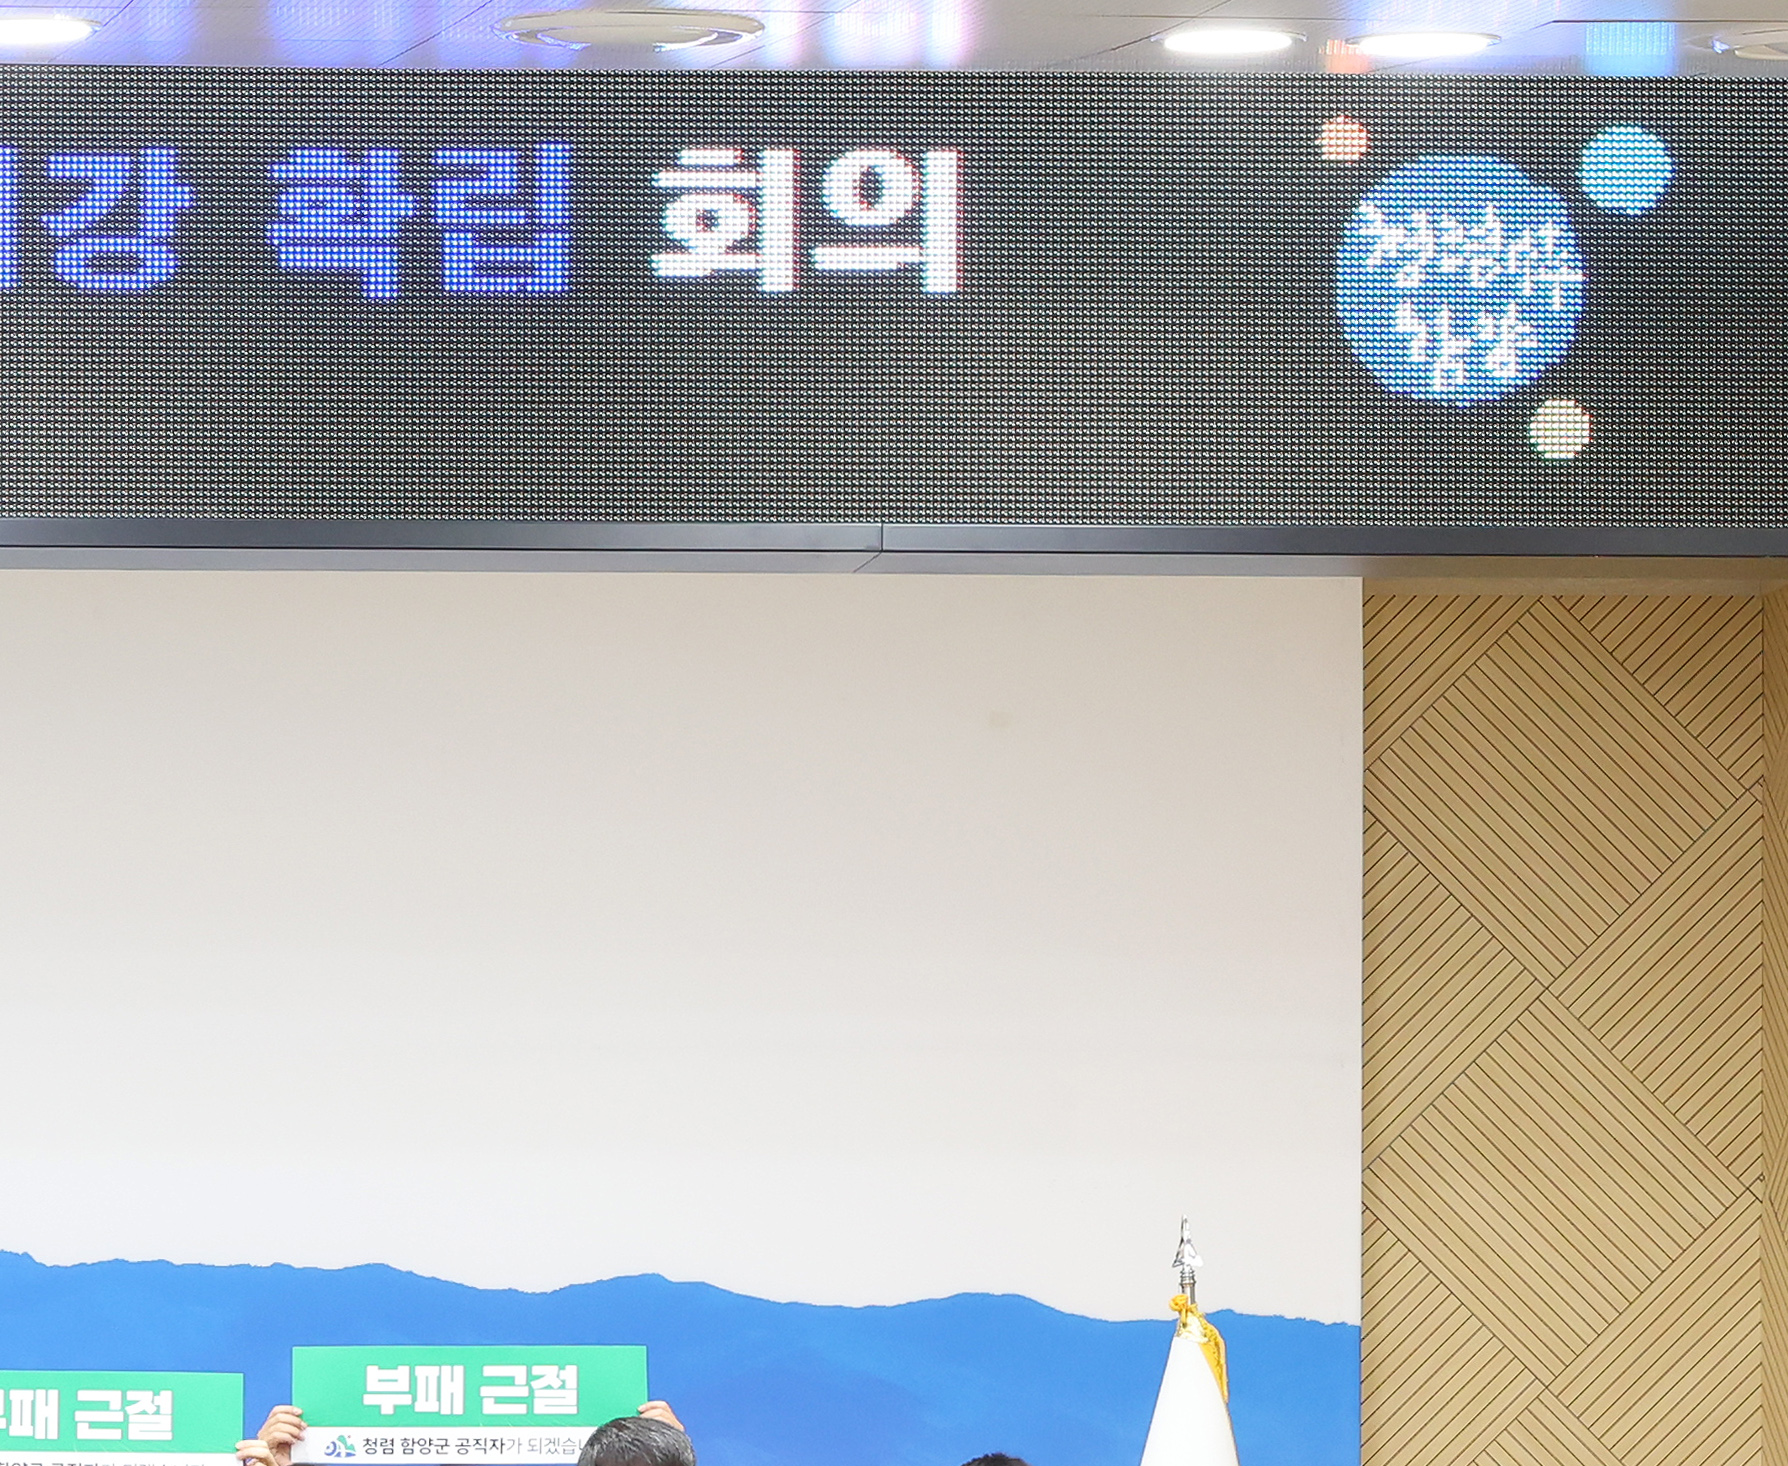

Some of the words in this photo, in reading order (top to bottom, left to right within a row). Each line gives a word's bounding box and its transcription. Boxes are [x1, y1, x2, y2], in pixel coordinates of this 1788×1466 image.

[265, 140, 570, 300] 확립
[648, 146, 964, 296] 회의
[74, 1390, 174, 1440] 근절
[362, 1365, 465, 1415] 부패
[479, 1365, 580, 1415] 근절
[362, 1437, 396, 1456] 청렴
[399, 1437, 451, 1455] 함양군
[455, 1437, 522, 1455] 공직자가
